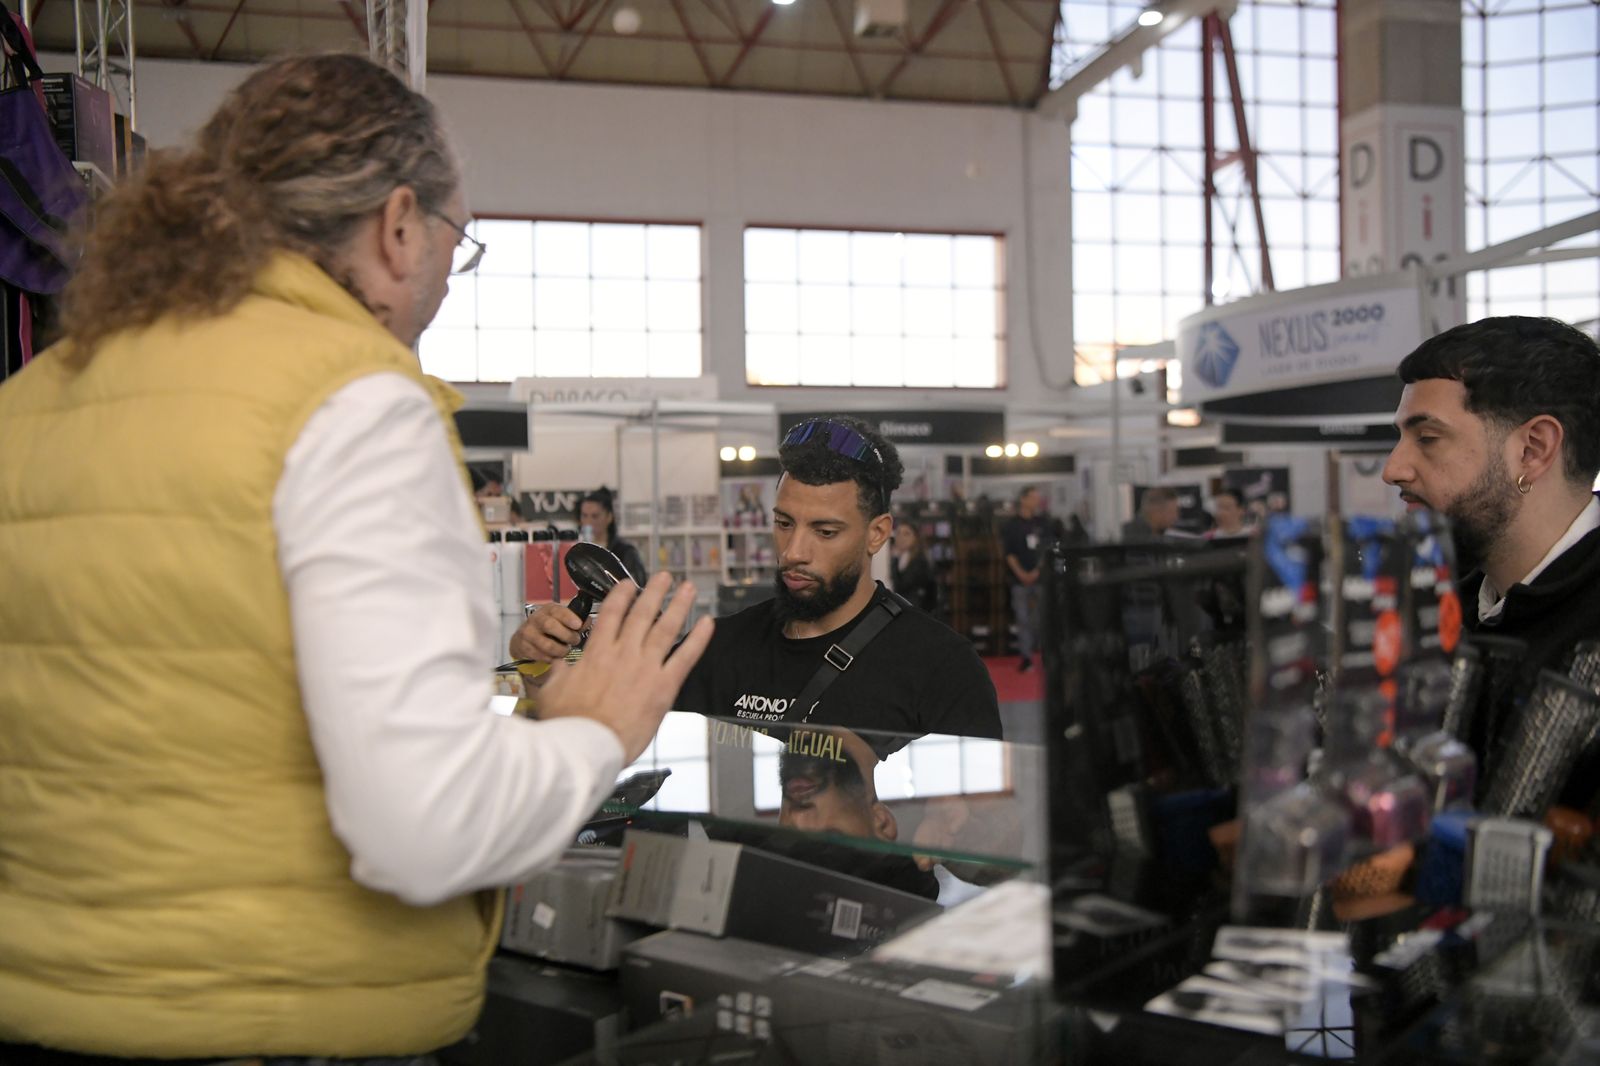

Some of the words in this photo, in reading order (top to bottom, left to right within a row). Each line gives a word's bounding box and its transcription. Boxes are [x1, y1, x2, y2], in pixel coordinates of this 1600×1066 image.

[1258, 311, 1328, 358] NEXUS
[1331, 302, 1385, 326] 2000
[734, 694, 788, 713] ANTONIO
[736, 709, 763, 720] ESCUELA
